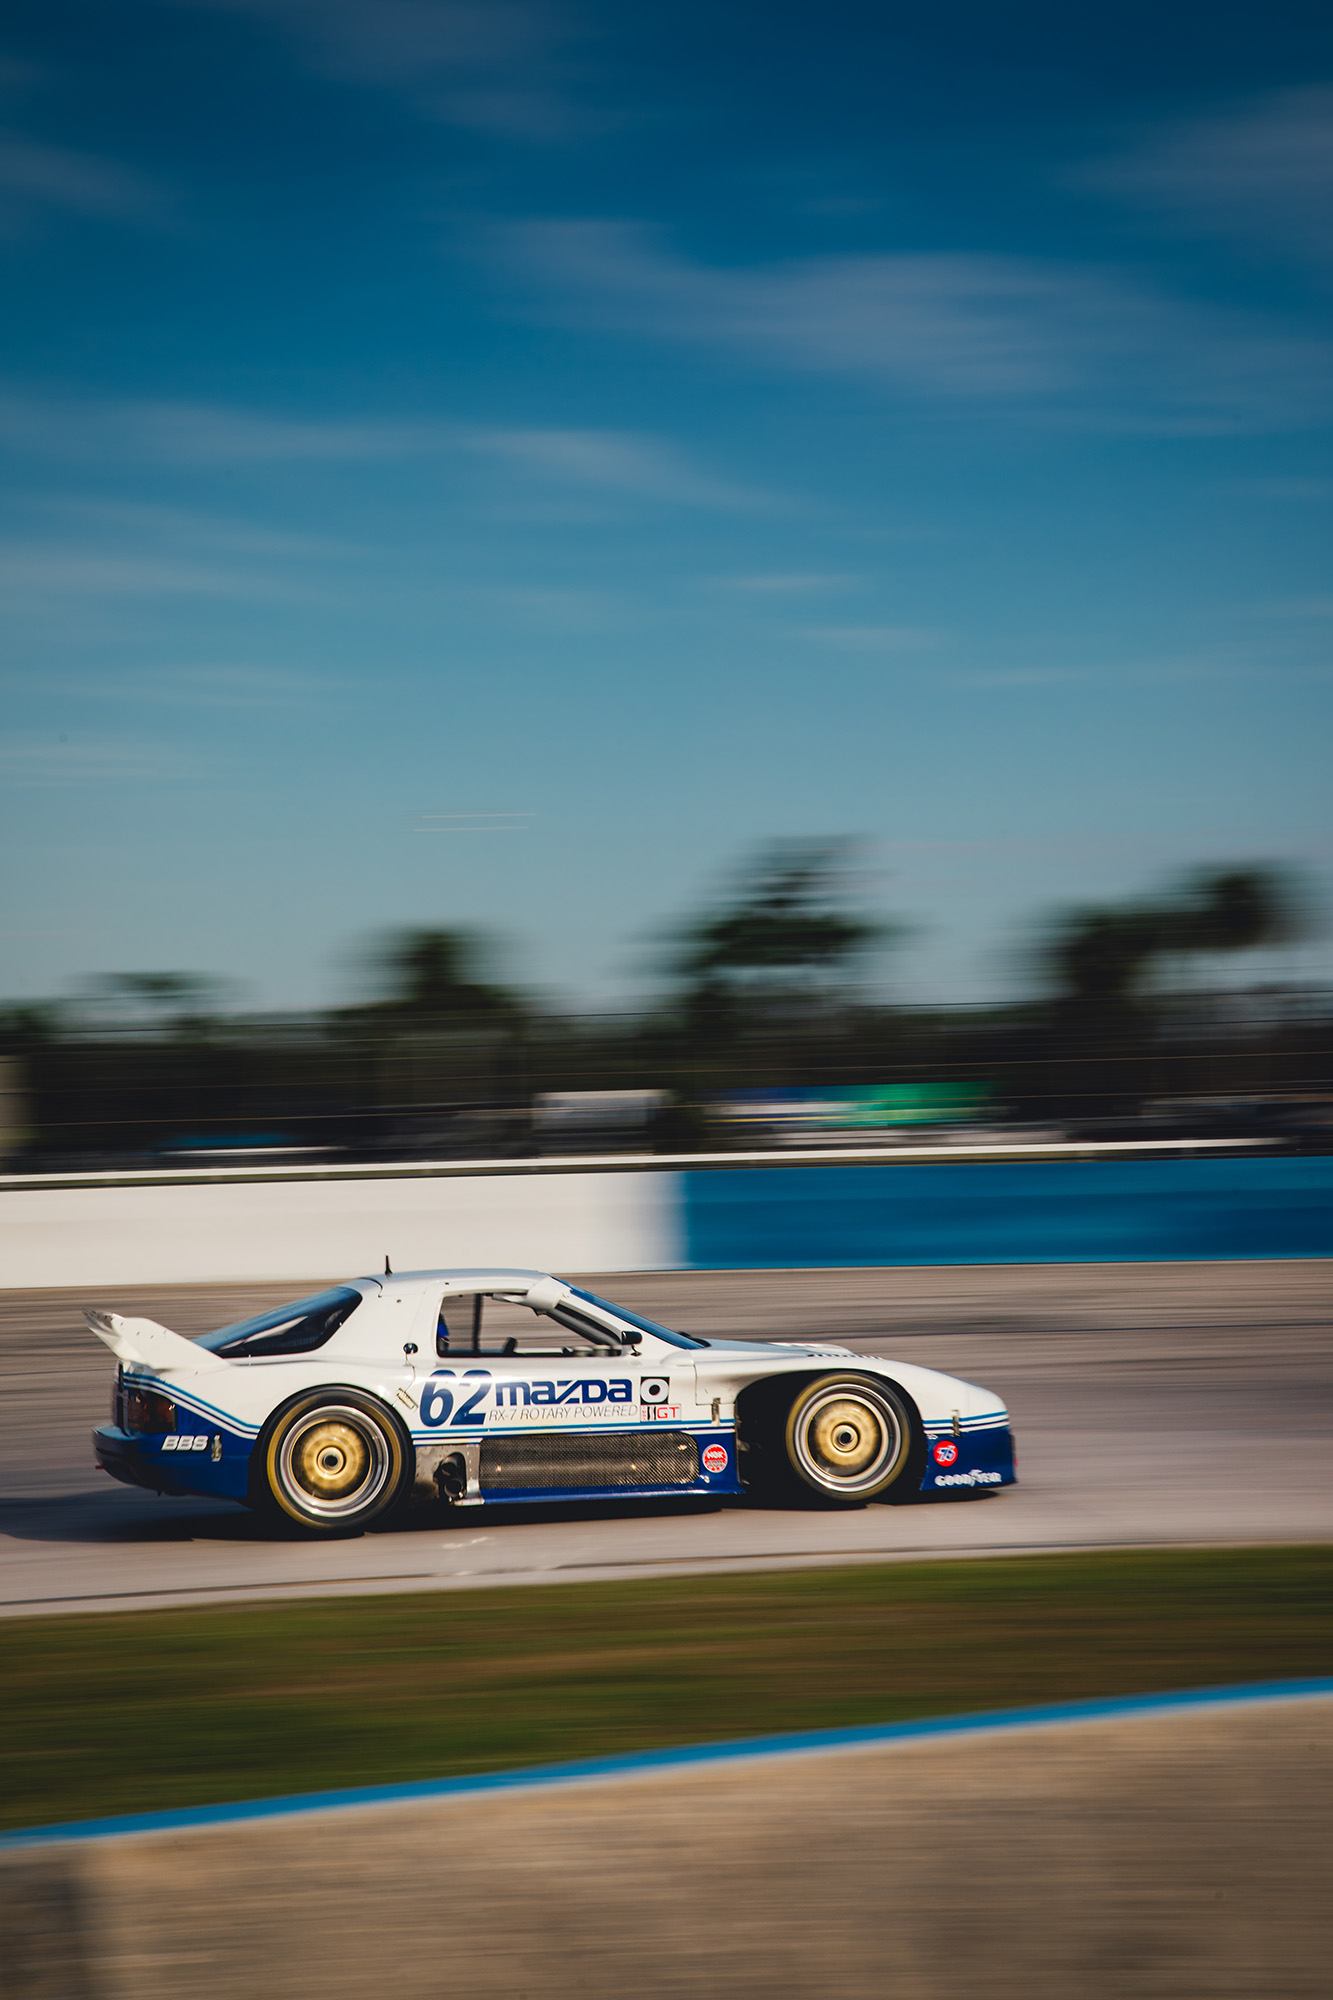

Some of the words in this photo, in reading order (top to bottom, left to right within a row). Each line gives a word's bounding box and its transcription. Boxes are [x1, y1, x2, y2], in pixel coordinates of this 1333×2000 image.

[419, 1370, 492, 1427] 62
[488, 1409, 517, 1421] RX-7
[520, 1406, 571, 1420] ROTARY
[574, 1403, 638, 1418] POWERED
[657, 1407, 680, 1418] GT
[161, 1435, 208, 1451] BBS
[937, 1445, 956, 1462] 76
